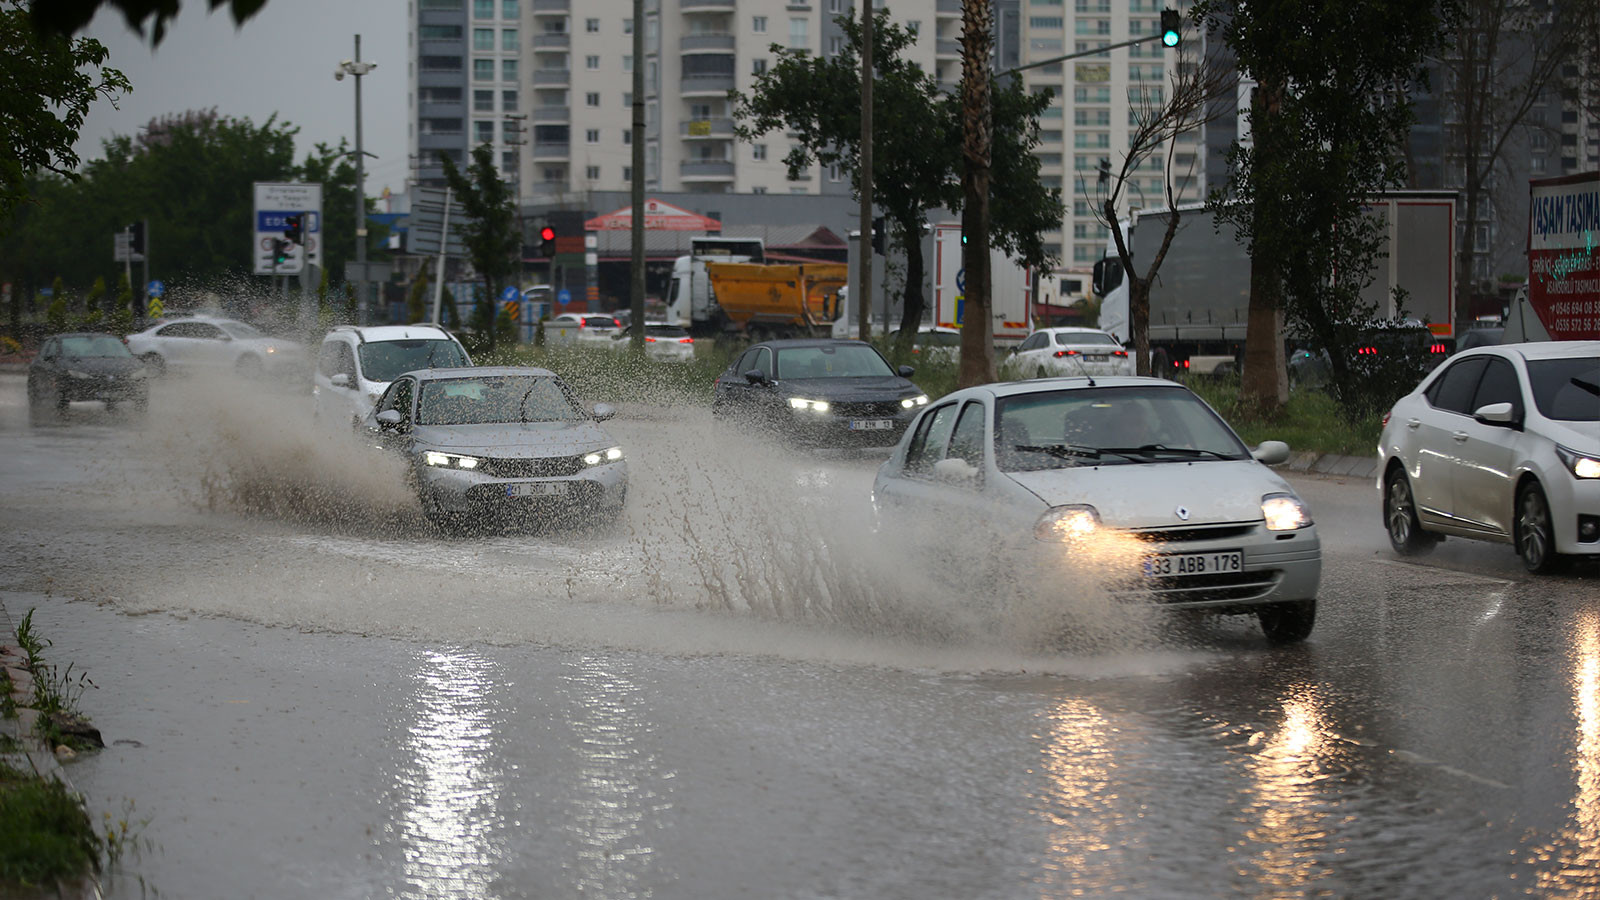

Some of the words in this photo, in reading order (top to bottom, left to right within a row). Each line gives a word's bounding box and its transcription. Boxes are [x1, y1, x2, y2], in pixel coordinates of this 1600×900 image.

[1532, 195, 1564, 241] YAŞAM
[1571, 302, 1583, 315] 694
[1571, 318, 1582, 331] 572
[1153, 558, 1171, 575] 33
[1178, 556, 1205, 573] ABB
[1213, 554, 1240, 571] 178
